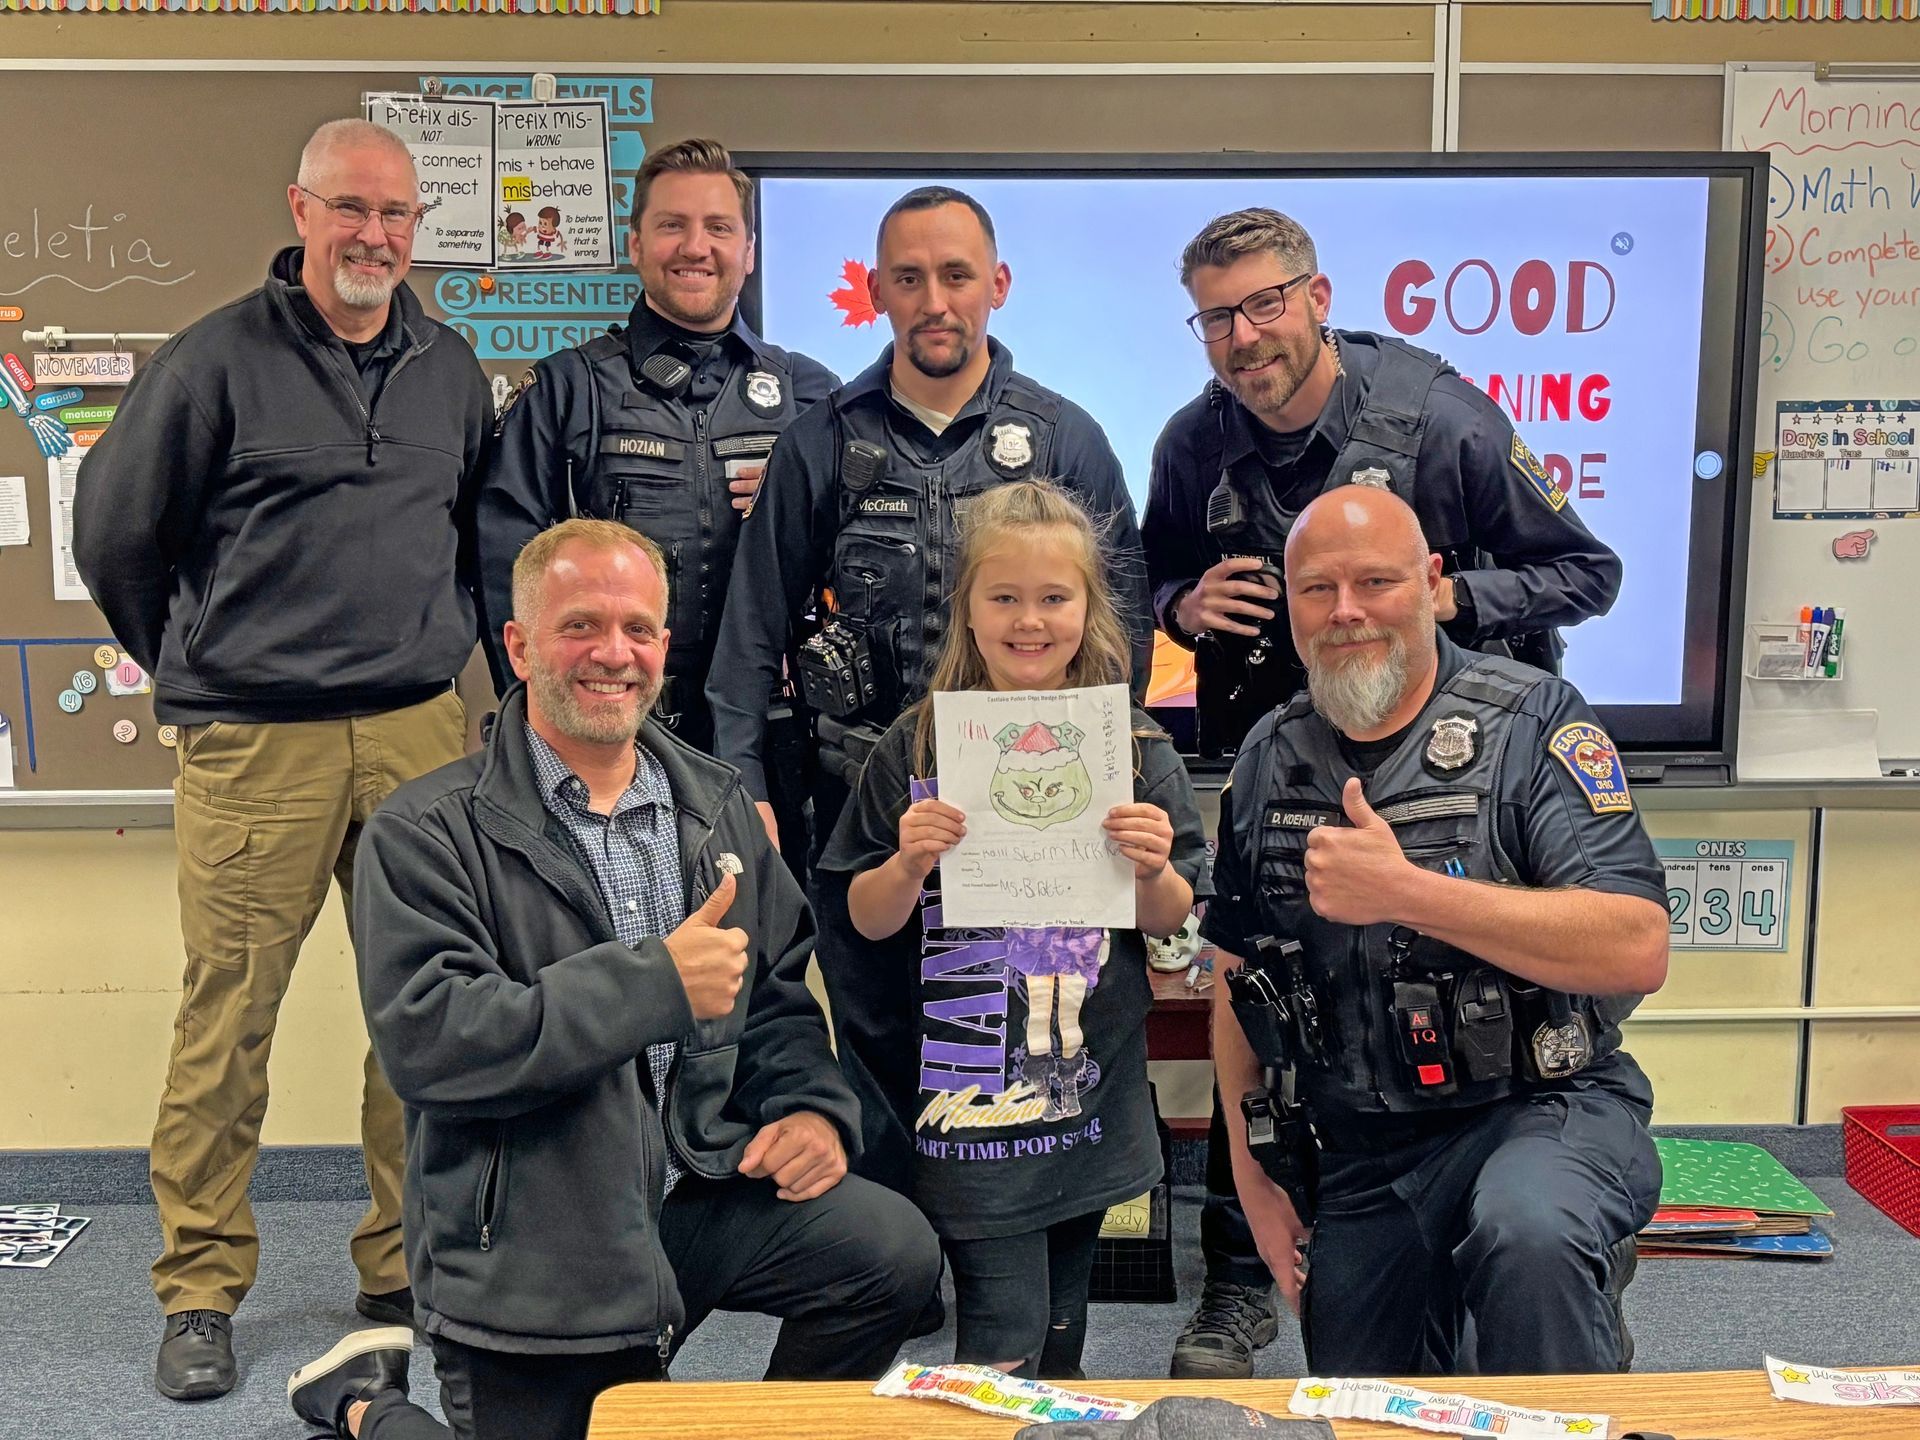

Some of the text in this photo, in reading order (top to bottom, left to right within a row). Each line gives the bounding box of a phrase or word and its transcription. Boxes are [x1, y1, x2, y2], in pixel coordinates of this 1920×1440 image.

[386, 107, 442, 126] Prefix
[420, 130, 442, 142] NOT
[526, 134, 562, 147] WRONG
[422, 153, 483, 169] connect
[499, 158, 522, 172] mis
[540, 155, 595, 171] behave
[503, 180, 593, 199] misbehave
[1802, 166, 1890, 215] Math
[575, 214, 604, 223] behave
[445, 228, 484, 238] separate
[574, 237, 590, 245] that
[437, 240, 482, 251] something
[574, 249, 599, 258] wrong
[1383, 258, 1616, 336] GOOD
[1798, 285, 1844, 309] use
[1807, 315, 1869, 364] Go
[7, 357, 30, 387] radius
[36, 356, 131, 377] NOVEMBER
[40, 390, 78, 406] carpals
[1781, 427, 1915, 449] Days in School
[619, 438, 665, 456] HOZIAN
[1781, 449, 1825, 459] Hundreds
[1839, 449, 1862, 458] Tens
[1884, 448, 1910, 458] Ones
[1555, 729, 1610, 752] EASTLAKE
[1595, 779, 1614, 789] OHIO
[1592, 792, 1628, 805] POLICE
[1272, 812, 1326, 827] D. KOEHNLE
[1696, 841, 1746, 857] ONES
[1664, 863, 1695, 872] ndreds
[1708, 863, 1731, 872] tens
[1751, 864, 1774, 872] ones
[1699, 888, 1732, 935] 3
[1741, 889, 1777, 936] 4
[1013, 1136, 1057, 1157] POP
